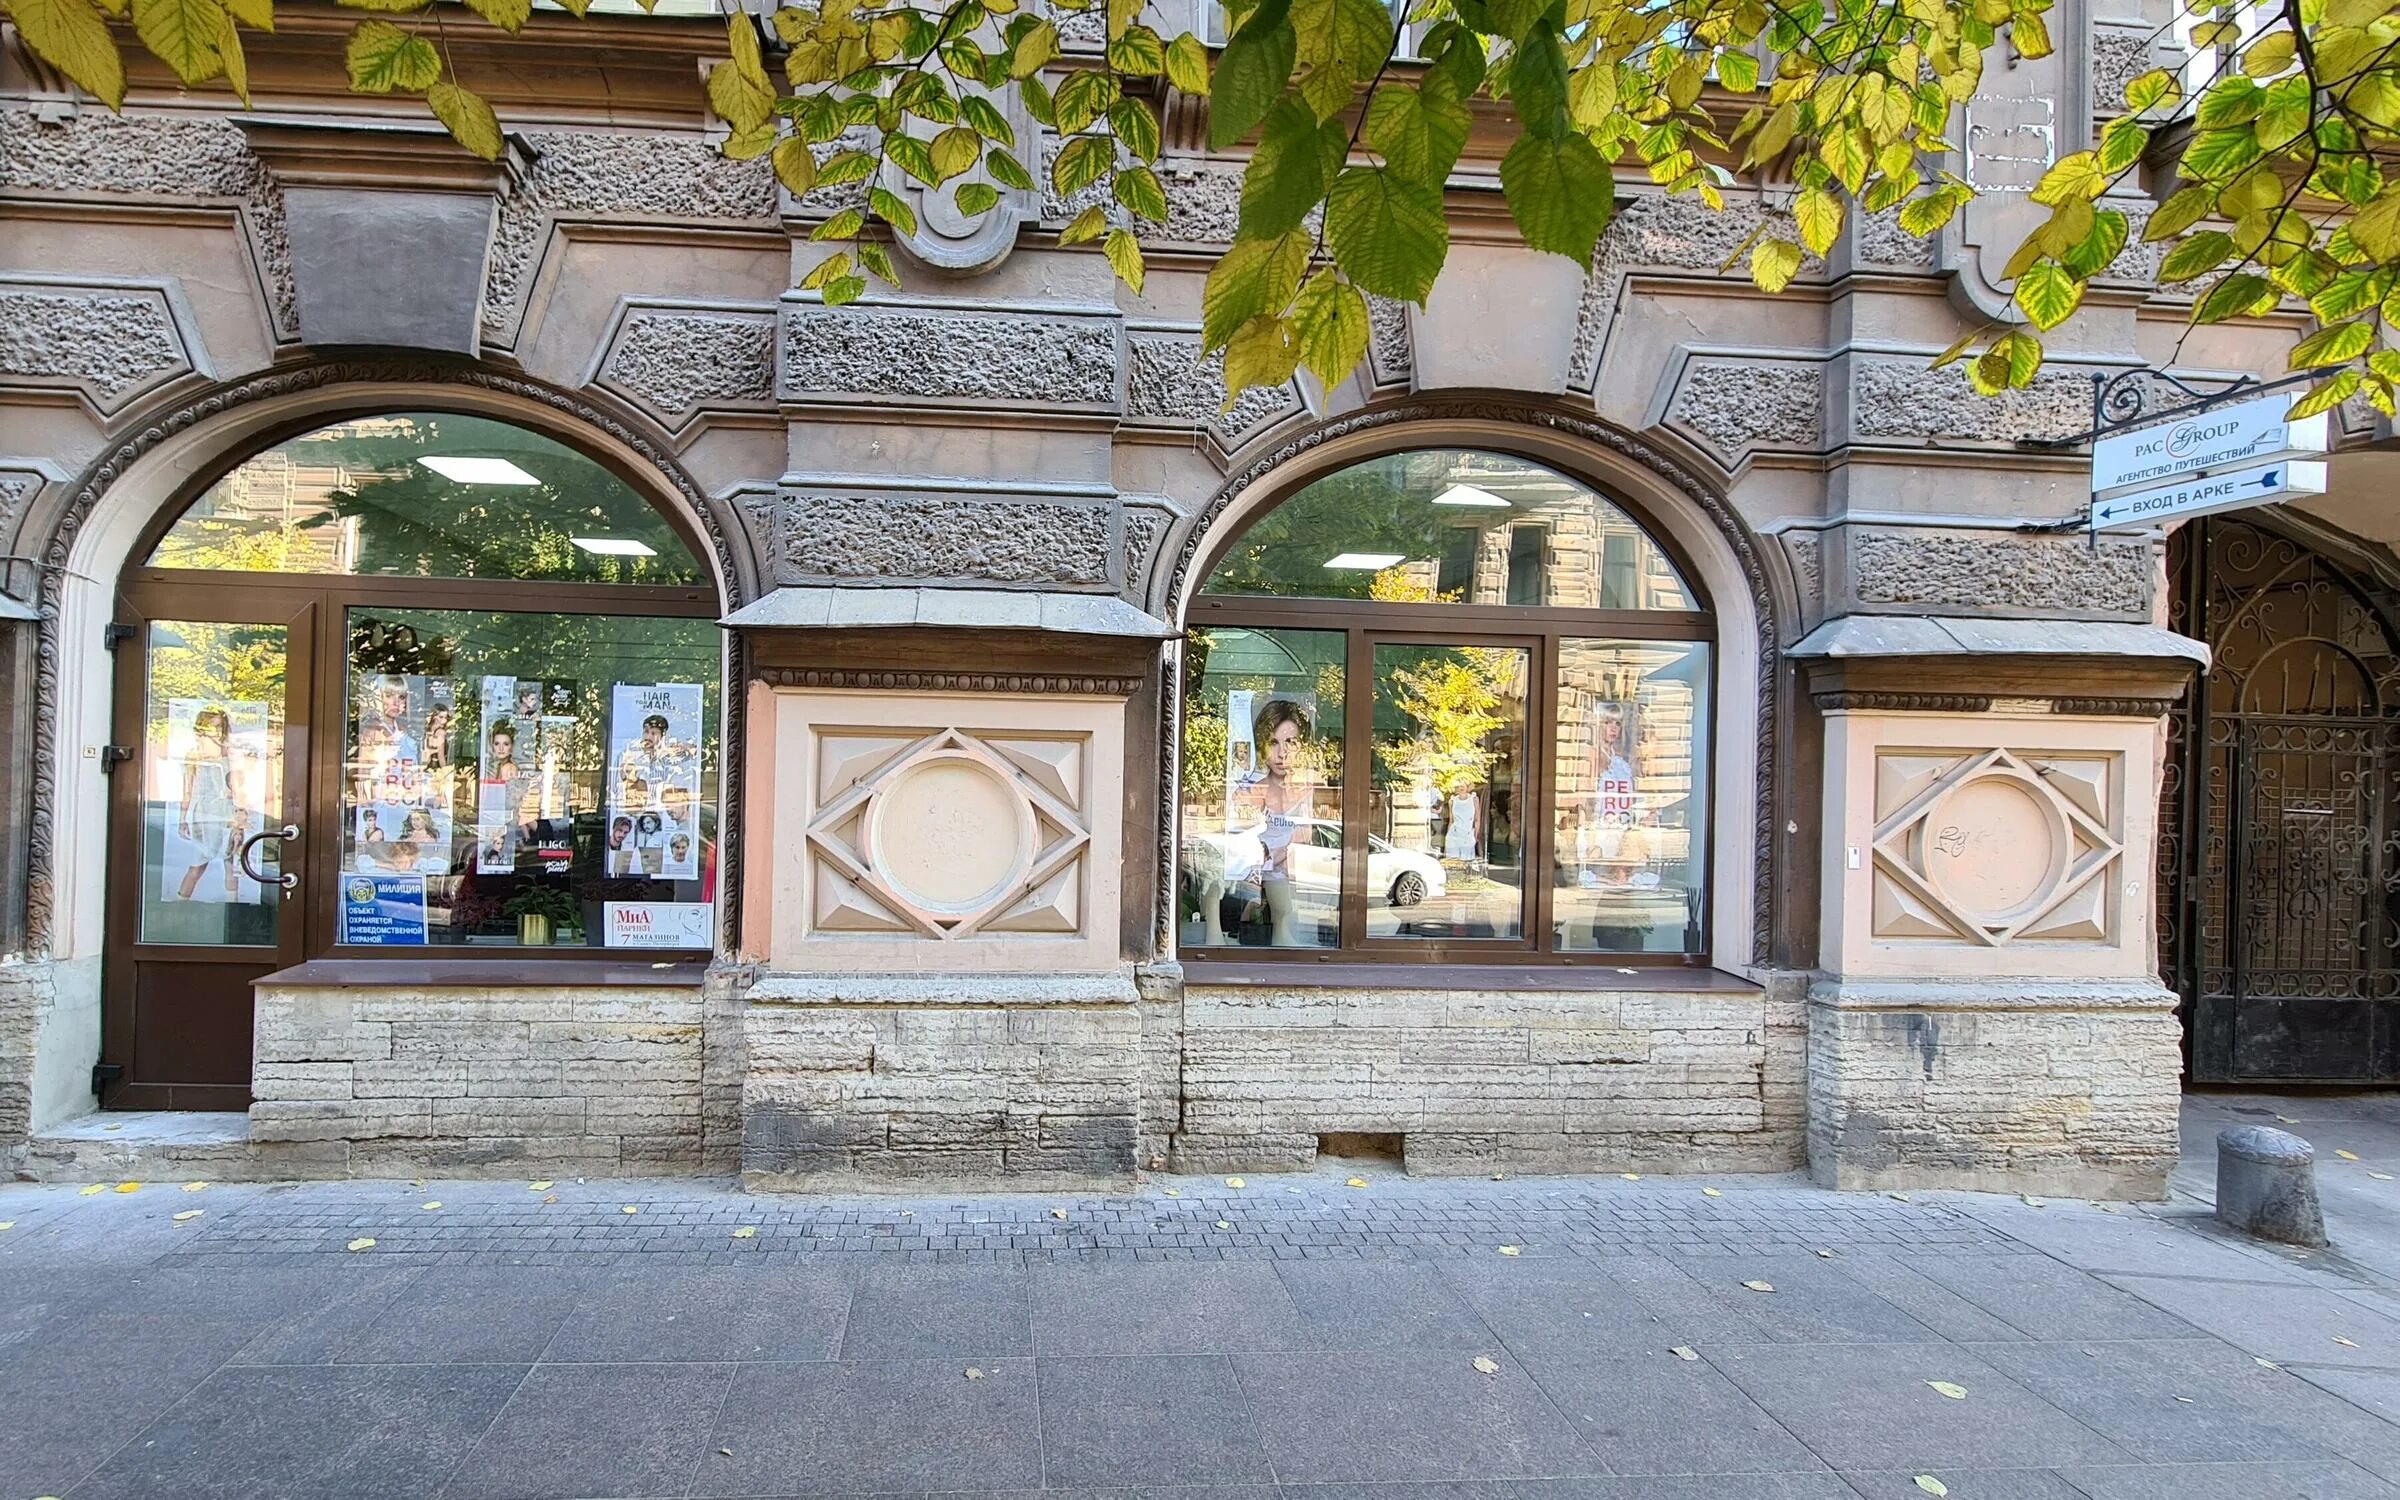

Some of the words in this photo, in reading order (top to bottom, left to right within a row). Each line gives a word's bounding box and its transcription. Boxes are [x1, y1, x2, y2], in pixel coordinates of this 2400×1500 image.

[2135, 440, 2164, 457] PAC
[2115, 464, 2172, 484] АГЕНТСТВО
[2174, 443, 2256, 471] ПУТЕШЕСТВИЙ
[2133, 495, 2173, 513] ВХОД
[2178, 492, 2188, 504] В
[2192, 482, 2235, 501] АРКЕ
[643, 691, 671, 701] HAIR
[1604, 780, 1629, 794] PE
[1604, 797, 1631, 810] RU
[377, 883, 422, 895] МИЛИЦИЯ
[348, 907, 375, 915] ОБЪЕКТ
[348, 916, 393, 925] ОХРАНЯЕТСЯ
[349, 935, 383, 944] ОХРАНОЙ
[621, 934, 631, 945] 7
